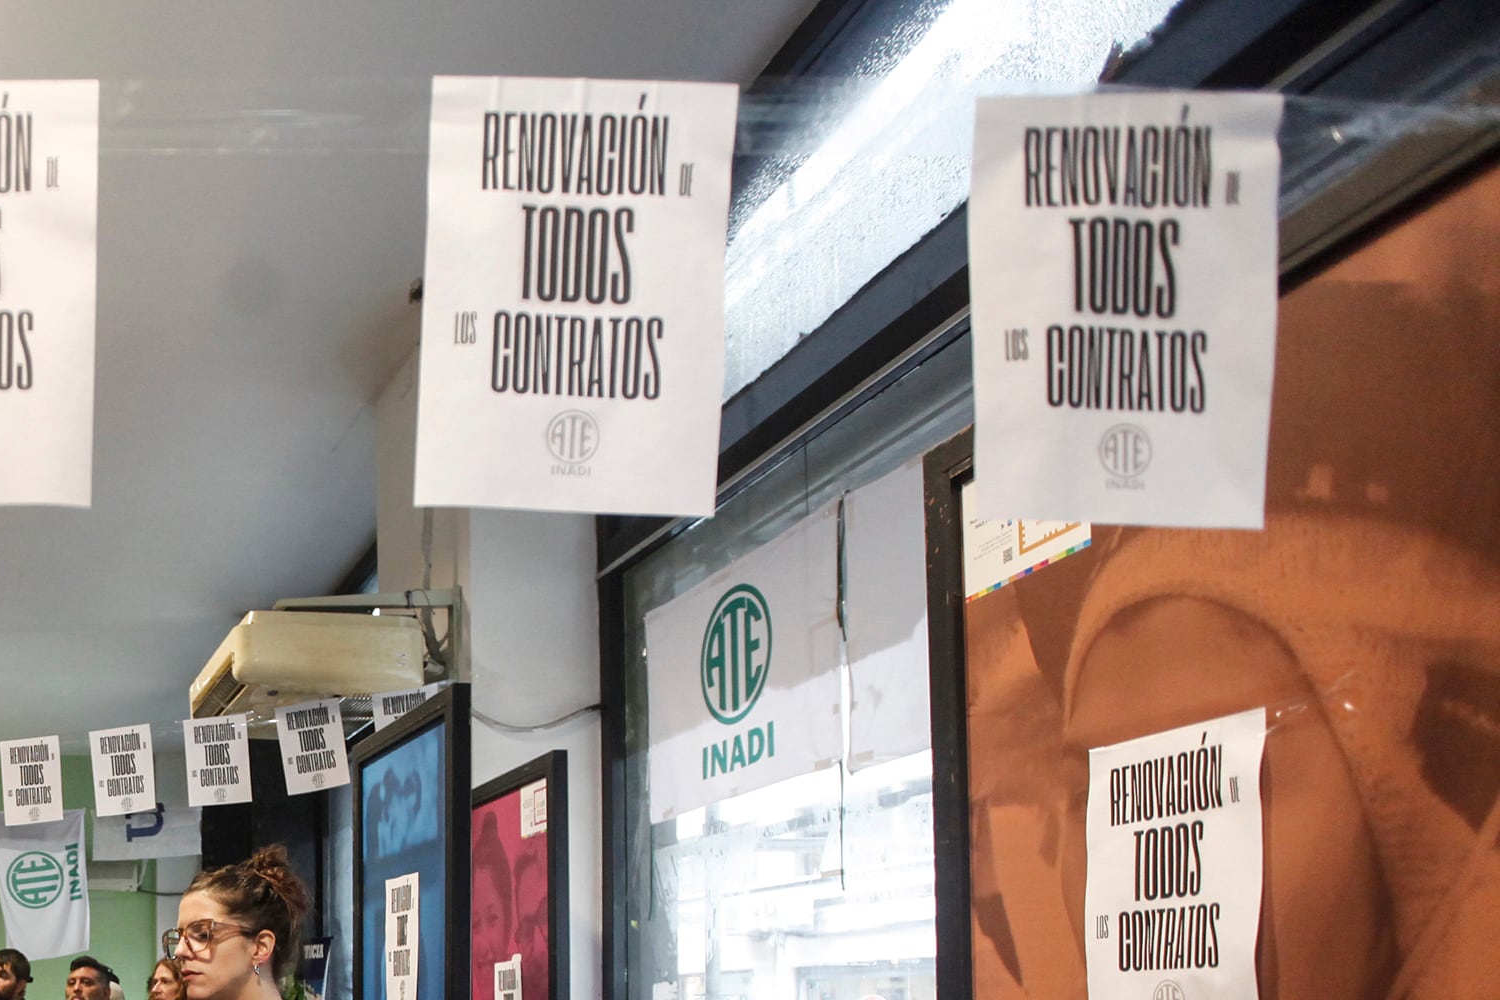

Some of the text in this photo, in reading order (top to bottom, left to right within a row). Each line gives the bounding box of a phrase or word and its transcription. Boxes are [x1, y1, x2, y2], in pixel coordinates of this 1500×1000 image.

[482, 92, 695, 197] RENOVACIÓN DE
[1024, 104, 1211, 208] RENOVACIÓN
[46, 156, 60, 189] DE
[522, 204, 634, 304] TODOS
[1069, 216, 1180, 319] TODOS
[454, 310, 664, 400] LOS CONTRATOS
[1045, 324, 1207, 413] CONTRATOS
[550, 413, 594, 461] ATE
[1104, 429, 1146, 473] ATE
[551, 465, 591, 476] INADI
[705, 595, 763, 713] ATE
[193, 718, 236, 744] RENOVACIÓN
[286, 703, 329, 731] RENOVACIÓN
[10, 740, 49, 764] RENOVACIÓN
[100, 729, 141, 754] RENOVACIÓN
[204, 743, 230, 766] TODOS
[296, 750, 336, 774] CONTRATOS
[298, 728, 326, 752] TODOS
[702, 720, 775, 780] INADI
[19, 764, 44, 786] TODOS
[107, 775, 144, 797] CONTRATOS
[110, 753, 136, 776] TODOS
[200, 766, 239, 787] CONTRATOS
[1110, 732, 1240, 826] RENOVACIÓN DE
[15, 786, 52, 806] CONTRATOS
[9, 854, 62, 906] ATE
[65, 843, 83, 901] INADI
[1134, 820, 1204, 901] TODOS
[1096, 902, 1221, 972] LOS CONTRATOS
